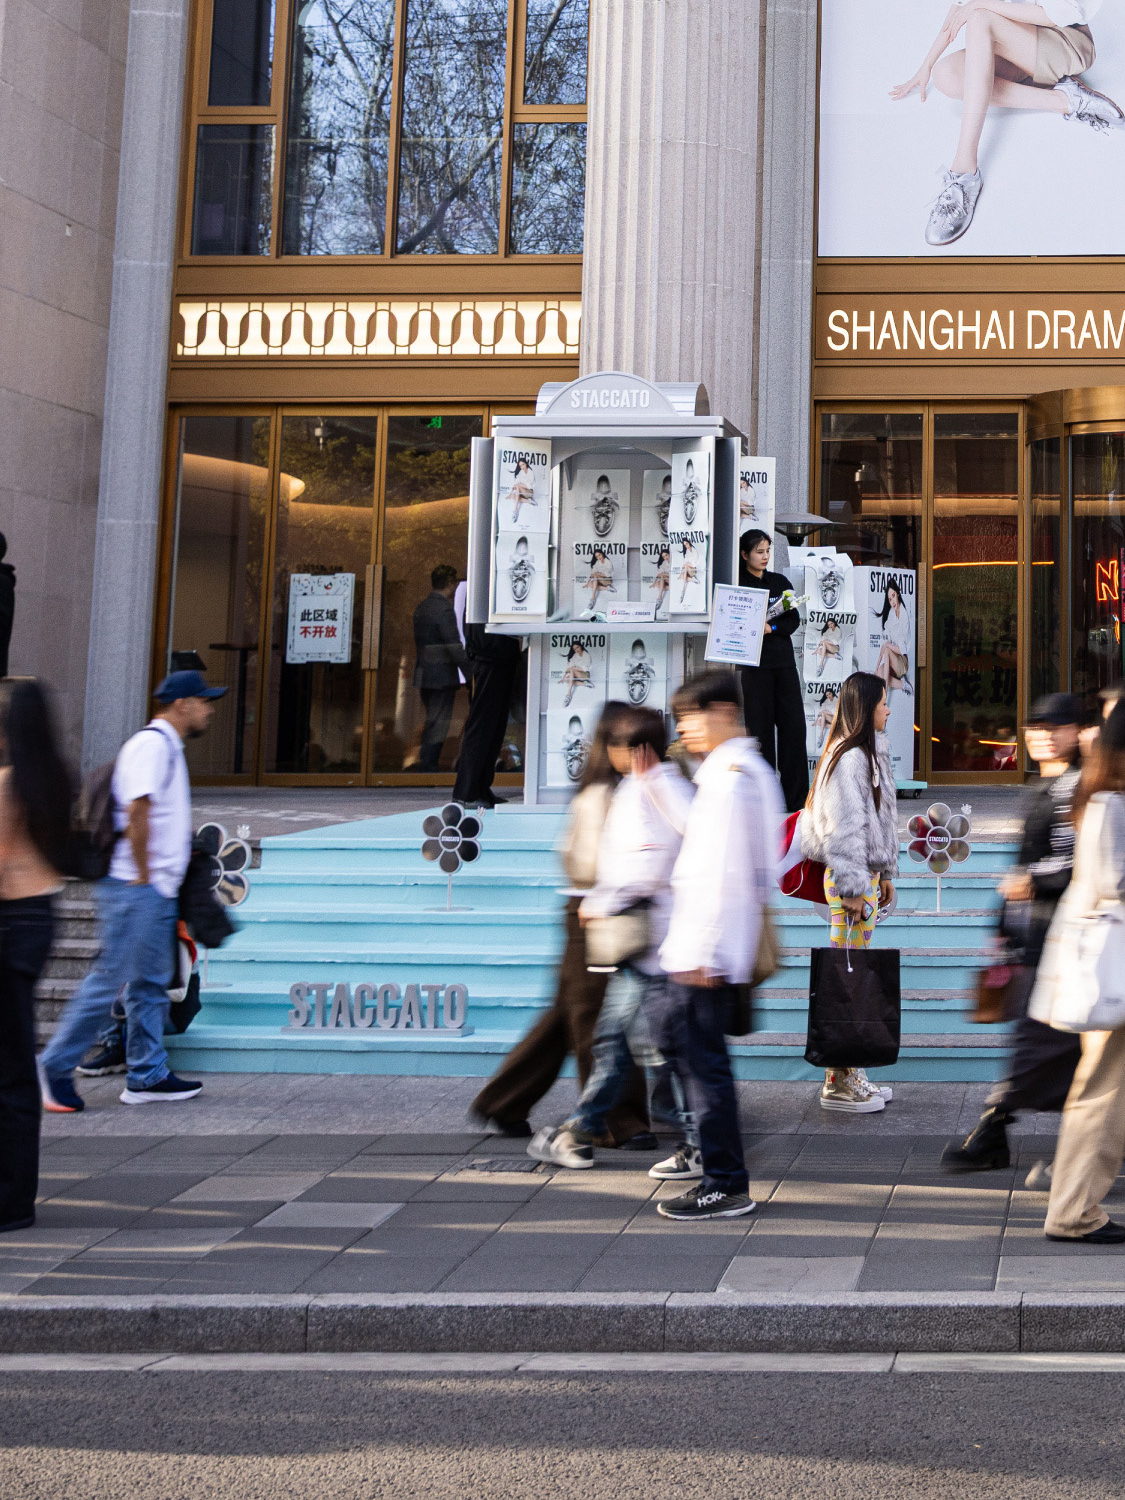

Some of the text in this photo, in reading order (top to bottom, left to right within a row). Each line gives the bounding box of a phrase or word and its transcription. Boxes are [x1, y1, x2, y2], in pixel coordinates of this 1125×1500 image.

[827, 309, 1015, 352] SHANGHAI
[570, 389, 650, 409] STACCATO
[300, 609, 338, 622] 此区域
[300, 625, 338, 638] 不开放
[288, 982, 470, 1029] STACCATO
